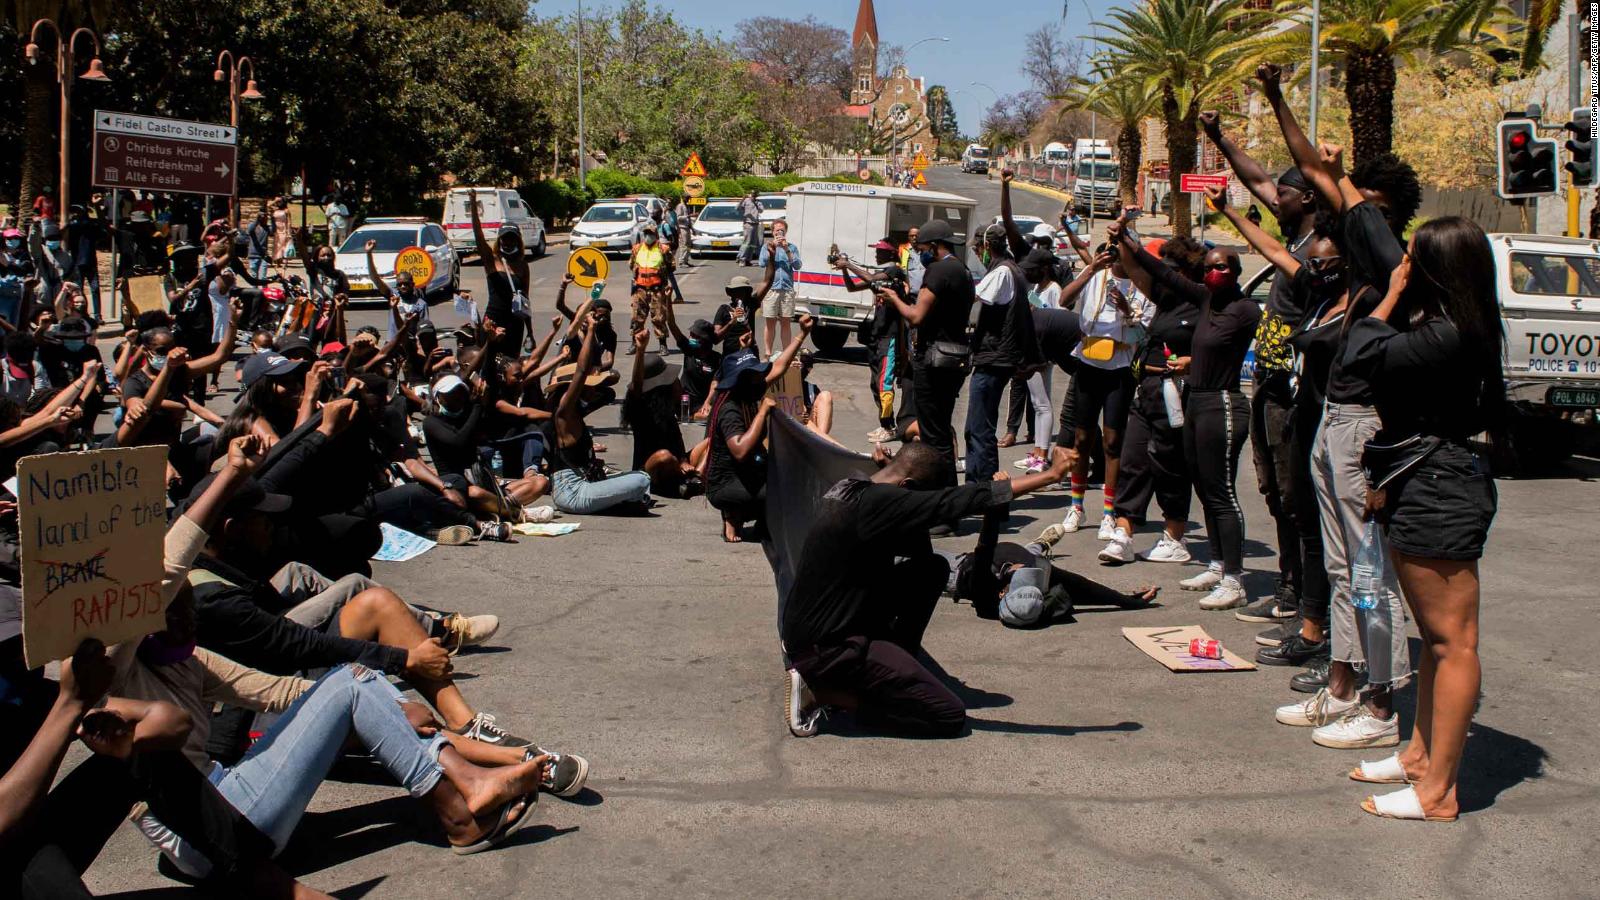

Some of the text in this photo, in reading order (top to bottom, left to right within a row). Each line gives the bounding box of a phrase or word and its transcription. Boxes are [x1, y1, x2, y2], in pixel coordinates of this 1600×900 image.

[115, 118, 219, 139] Fidel Castro Street
[126, 141, 210, 159] Christus Kirche
[125, 156, 204, 173] Reiterdenkmal
[125, 171, 182, 185] Alte Feste
[810, 182, 862, 192] POLICE 10111
[403, 253, 423, 265] ROAD
[1529, 358, 1600, 373] POLICE 10
[29, 459, 139, 504] Namibia
[36, 495, 165, 549] land of the
[72, 580, 162, 633] RAPISTS
